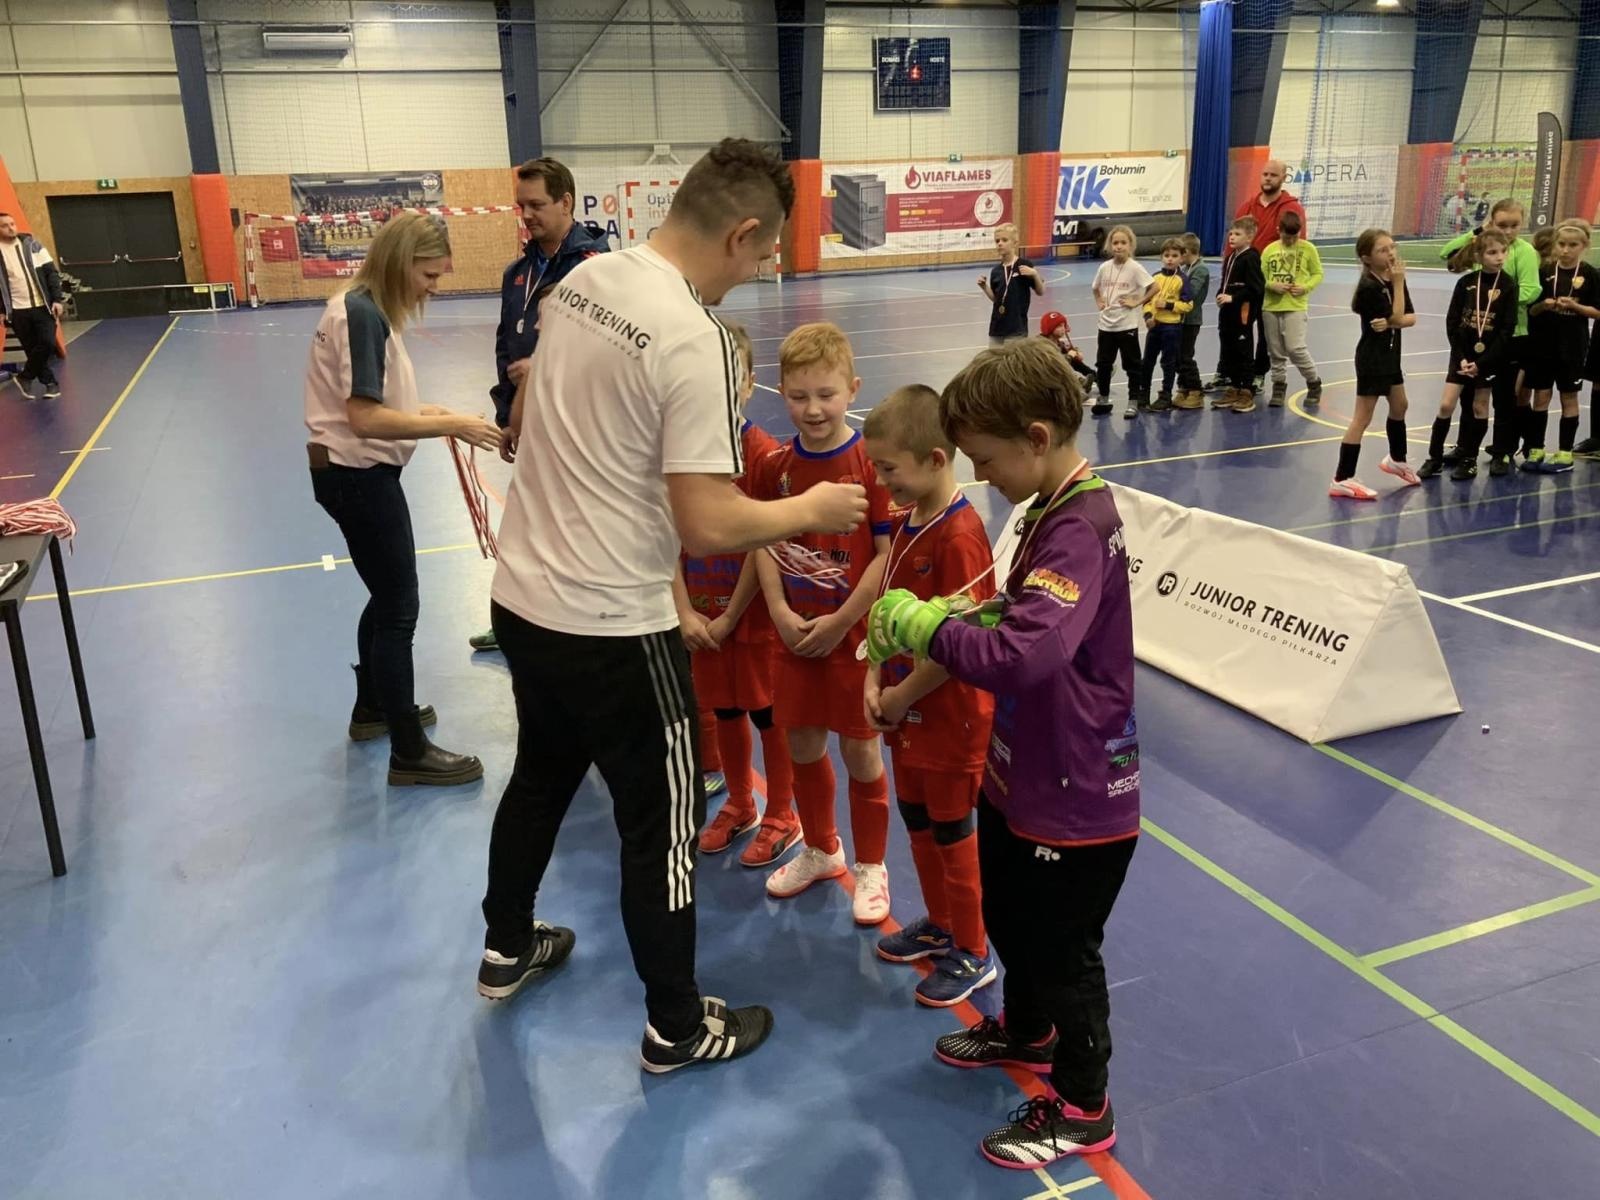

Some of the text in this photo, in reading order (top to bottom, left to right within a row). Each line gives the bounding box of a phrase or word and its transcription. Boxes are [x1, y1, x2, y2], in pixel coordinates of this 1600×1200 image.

[922, 169, 992, 182] VIAFLAMES
[589, 303, 652, 350] TRENING
[1190, 581, 1350, 652] JUNIOR TRENING
